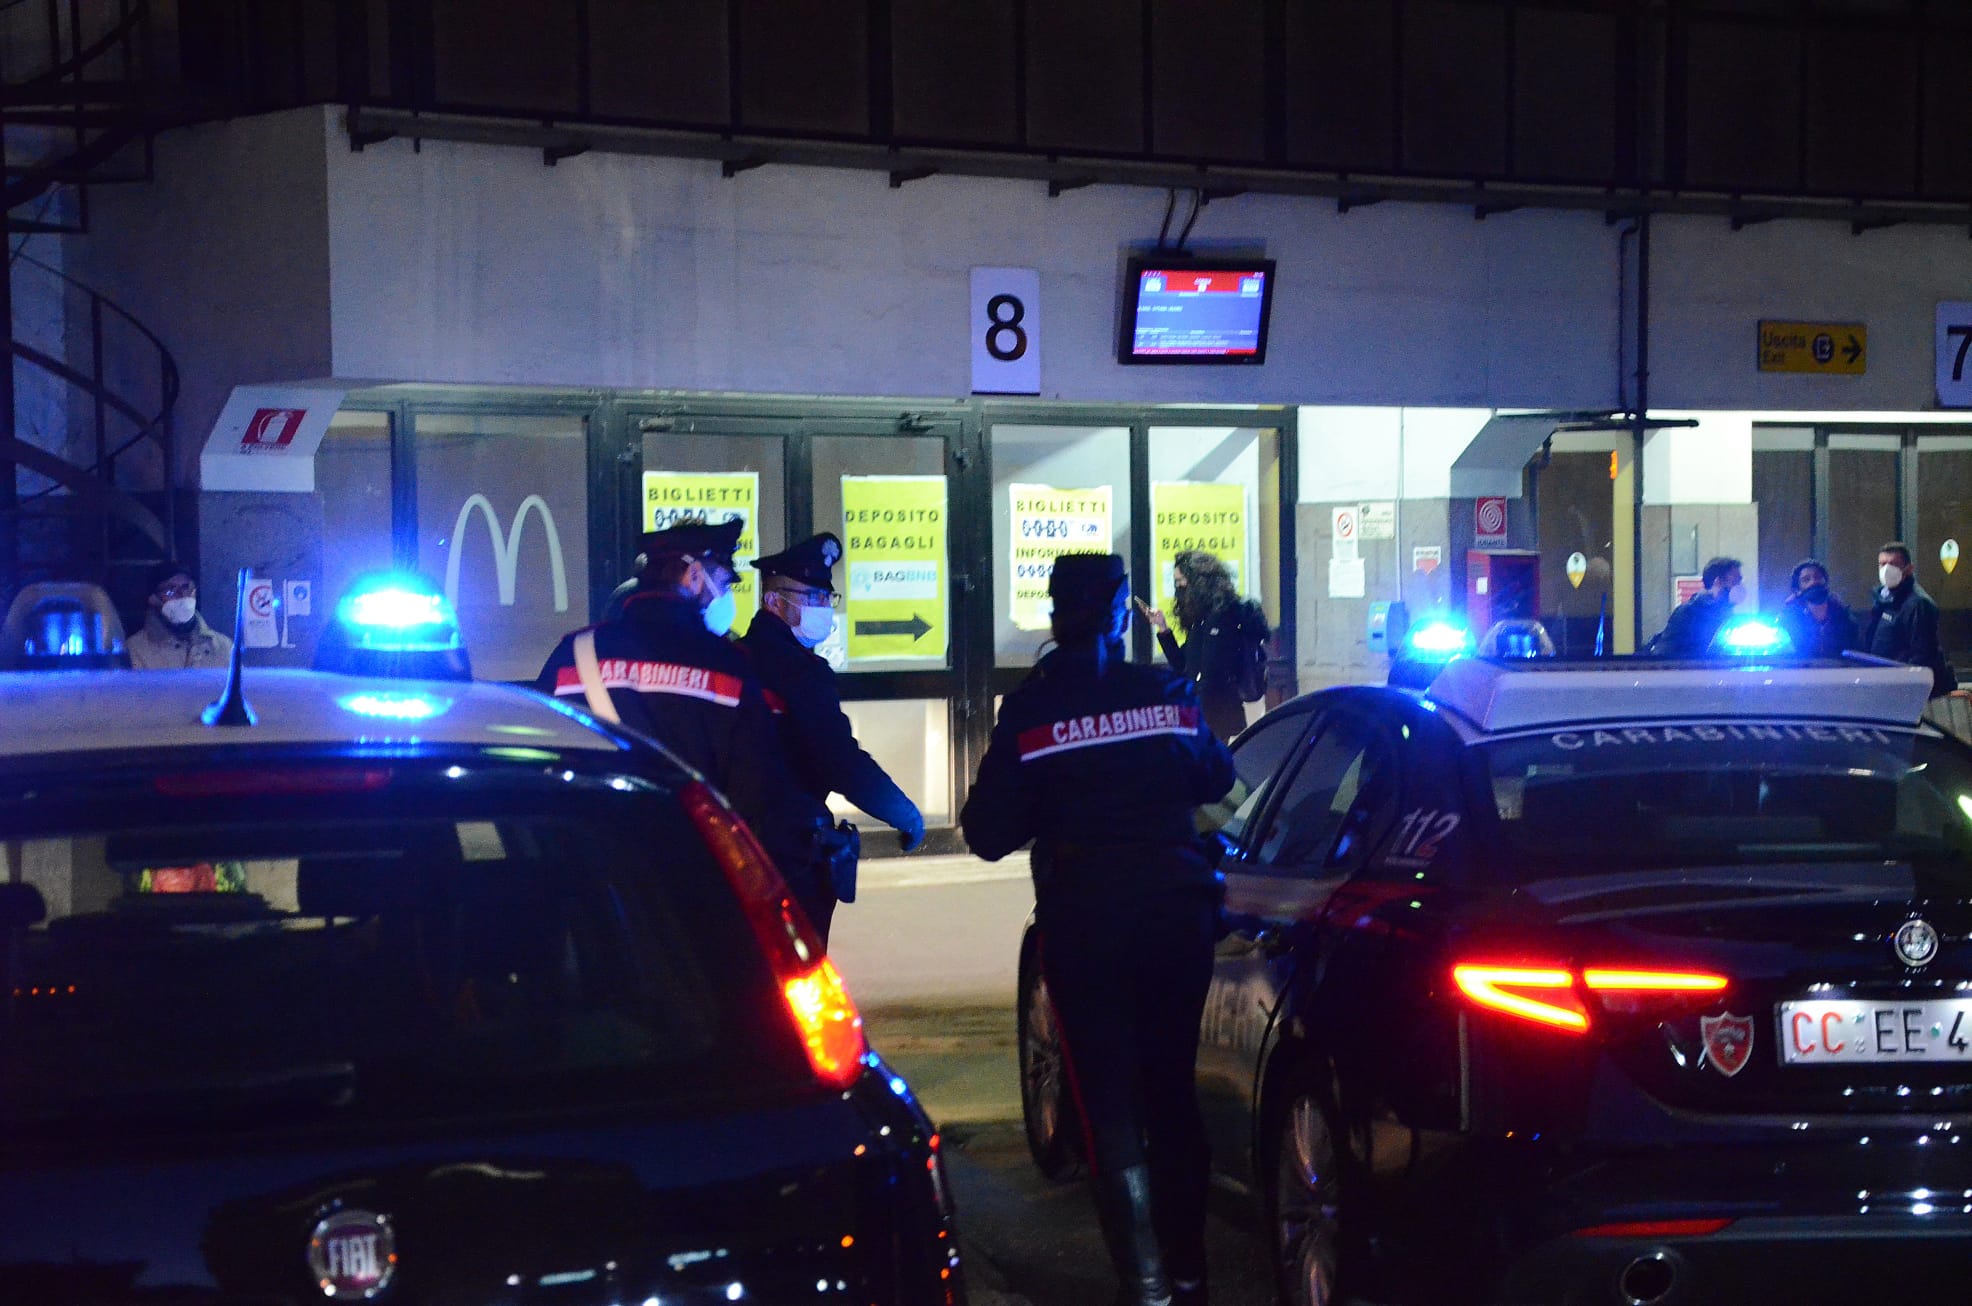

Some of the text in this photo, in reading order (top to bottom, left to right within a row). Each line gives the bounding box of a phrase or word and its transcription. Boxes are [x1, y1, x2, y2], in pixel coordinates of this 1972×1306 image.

[985, 293, 1028, 362] 8
[1762, 331, 1807, 350] Uscita
[1947, 325, 1972, 381] 7
[648, 487, 752, 501] BIGLIETTI
[1016, 500, 1106, 513] BIGLIETTI
[845, 510, 939, 522] DEPOSITO
[1157, 512, 1240, 525] DEPOSITO
[850, 536, 934, 549] BAGAGLI
[1162, 537, 1236, 550] BAGAGLI
[601, 659, 710, 690] ARABINIERI
[1052, 704, 1181, 744] CARABINIERI
[1551, 724, 1890, 750] CARABINIERI
[1392, 807, 1461, 857] 112
[1792, 1008, 1969, 1055] CC EE 4
[327, 1232, 381, 1278] FIAT
